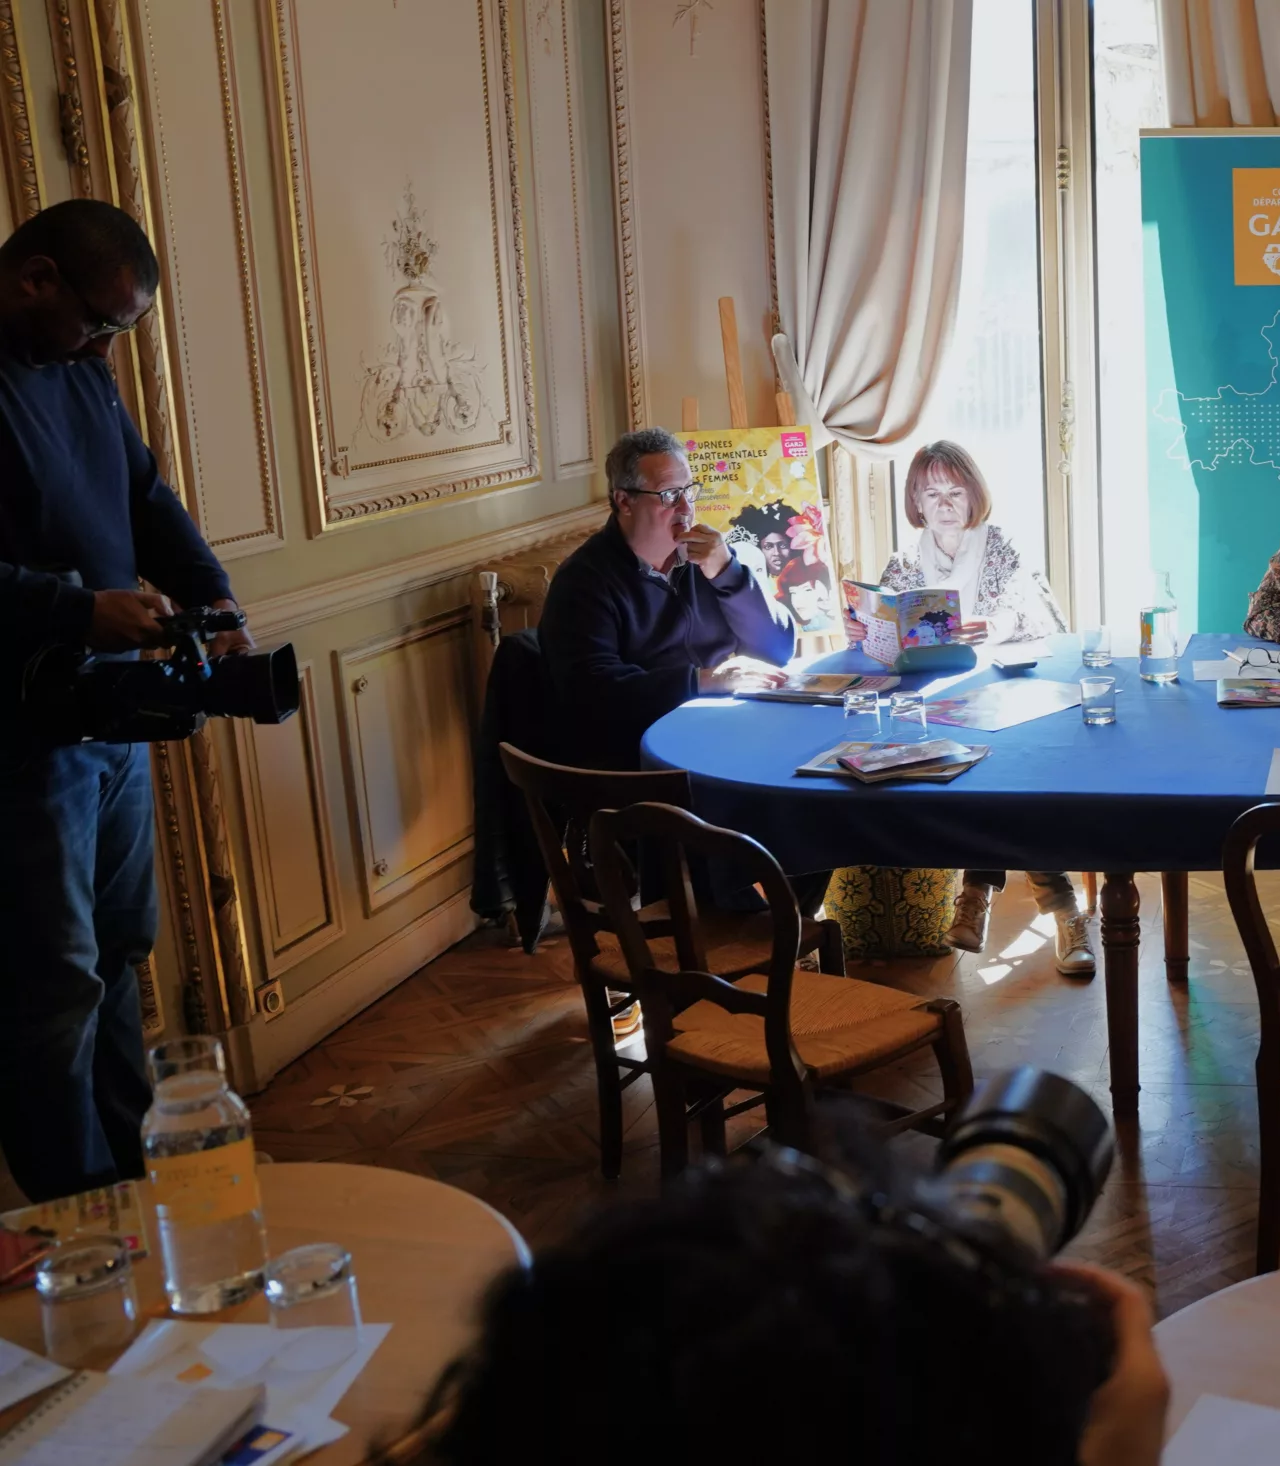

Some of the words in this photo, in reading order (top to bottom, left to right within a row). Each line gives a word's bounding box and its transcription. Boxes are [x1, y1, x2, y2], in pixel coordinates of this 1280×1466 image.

[688, 449, 768, 461] ÉPARTEMENTALES
[690, 464, 699, 473] ES
[702, 473, 739, 483] FEMMES
